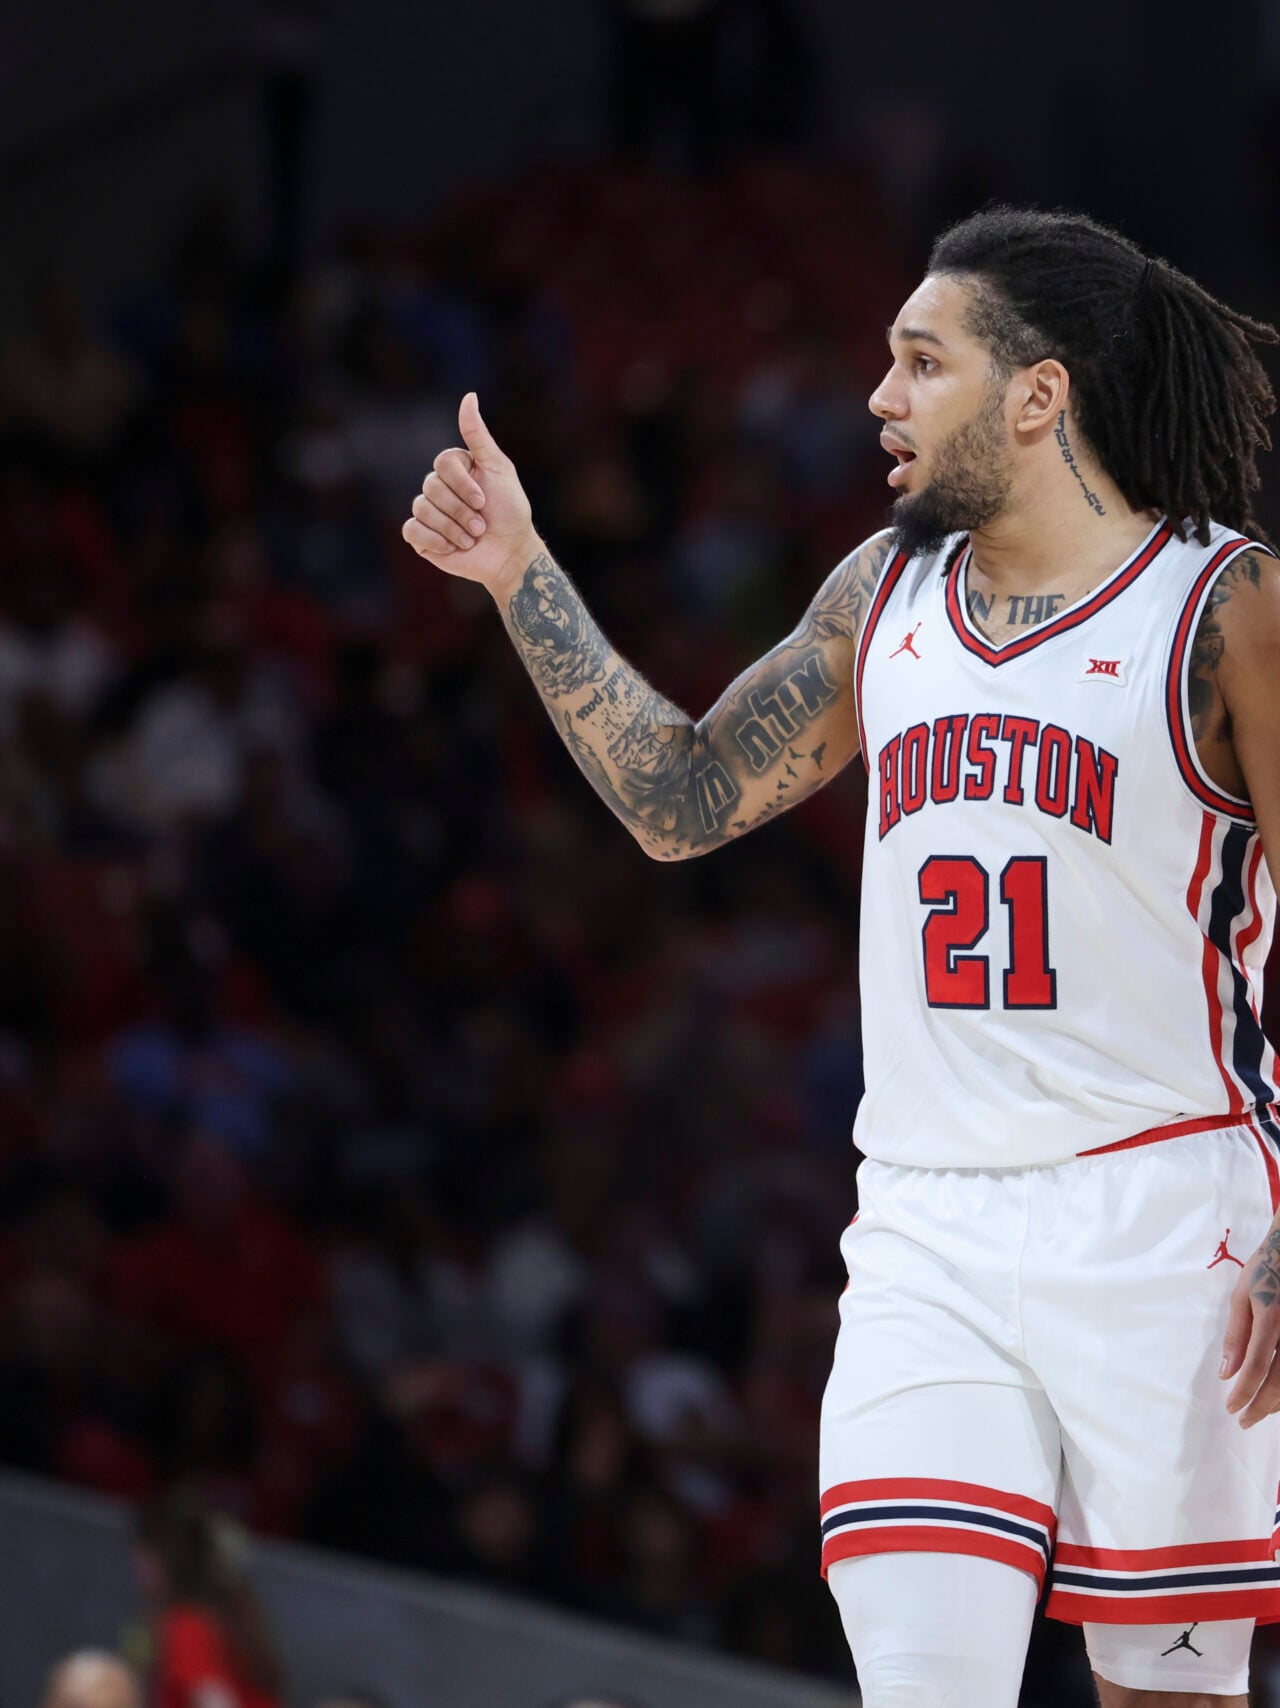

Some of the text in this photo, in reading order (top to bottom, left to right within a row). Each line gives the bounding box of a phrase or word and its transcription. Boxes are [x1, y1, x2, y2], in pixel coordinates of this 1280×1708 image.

[1053, 410, 1106, 516] Justine
[1006, 593, 1066, 625] THE
[1085, 658, 1121, 677] XII
[576, 688, 604, 721] pass
[878, 713, 1119, 846] HOUSTON
[917, 855, 1057, 1010] 21
